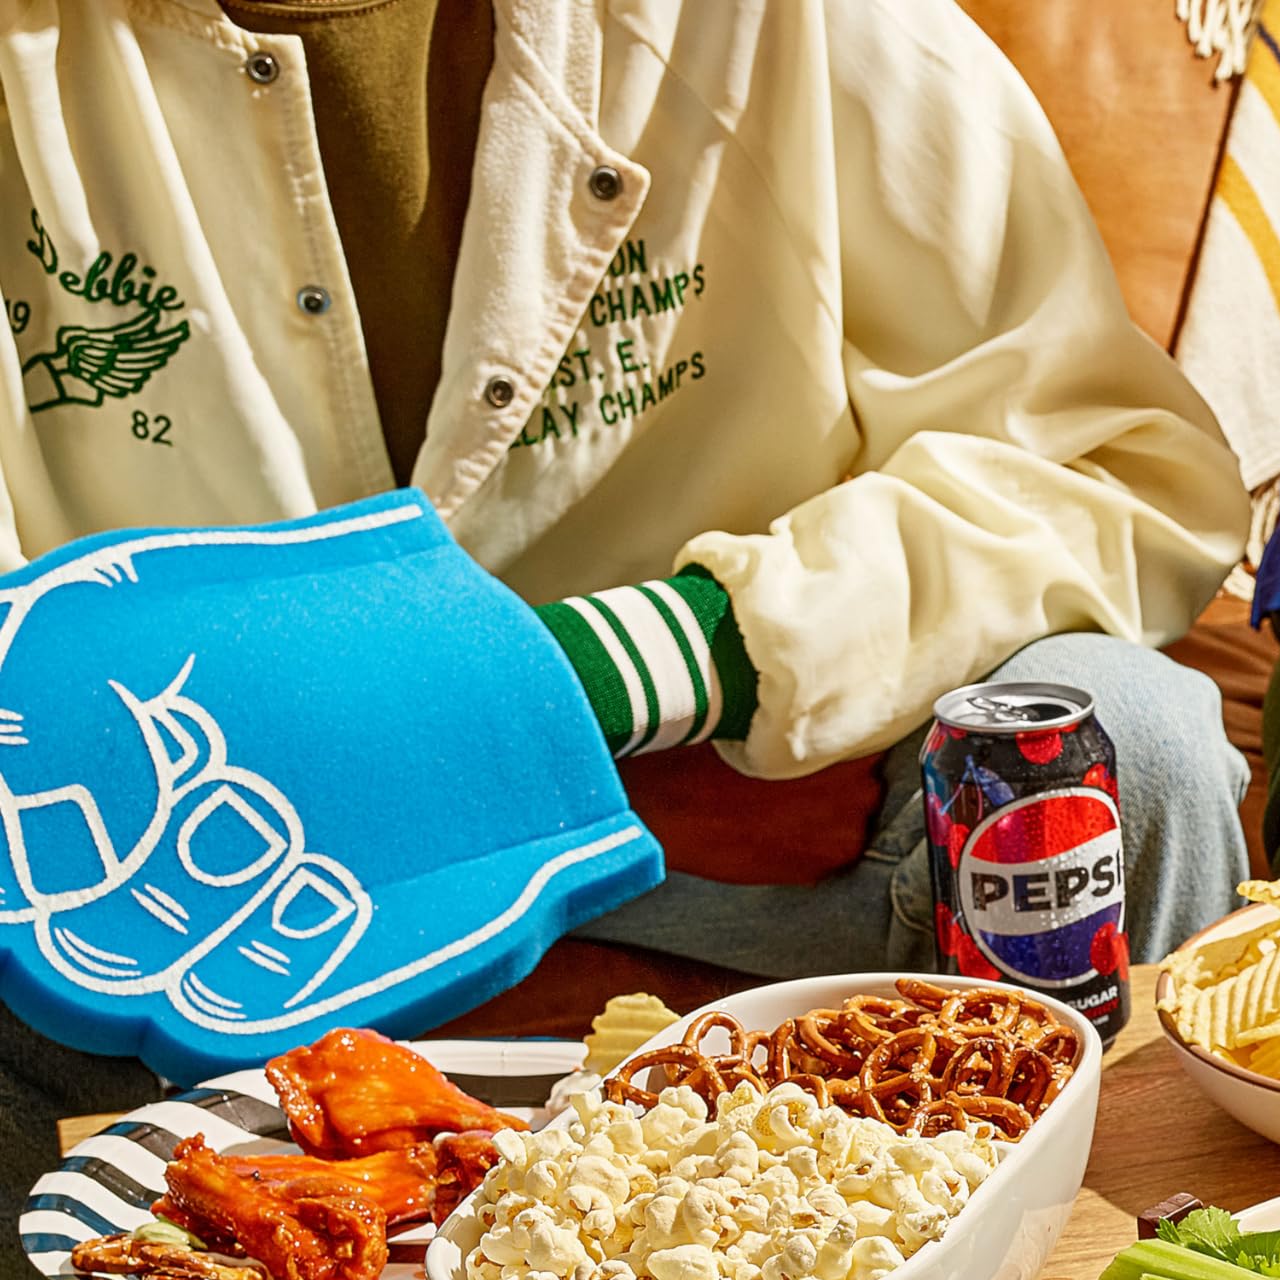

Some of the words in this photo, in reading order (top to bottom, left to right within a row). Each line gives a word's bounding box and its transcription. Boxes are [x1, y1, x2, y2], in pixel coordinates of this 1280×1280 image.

[27, 207, 185, 311] Debbie
[590, 264, 704, 327] CHAMPS
[599, 351, 705, 425] CHAMPS
[616, 340, 648, 373] E.
[131, 410, 173, 447] 82
[971, 848, 1122, 912] PEPSI
